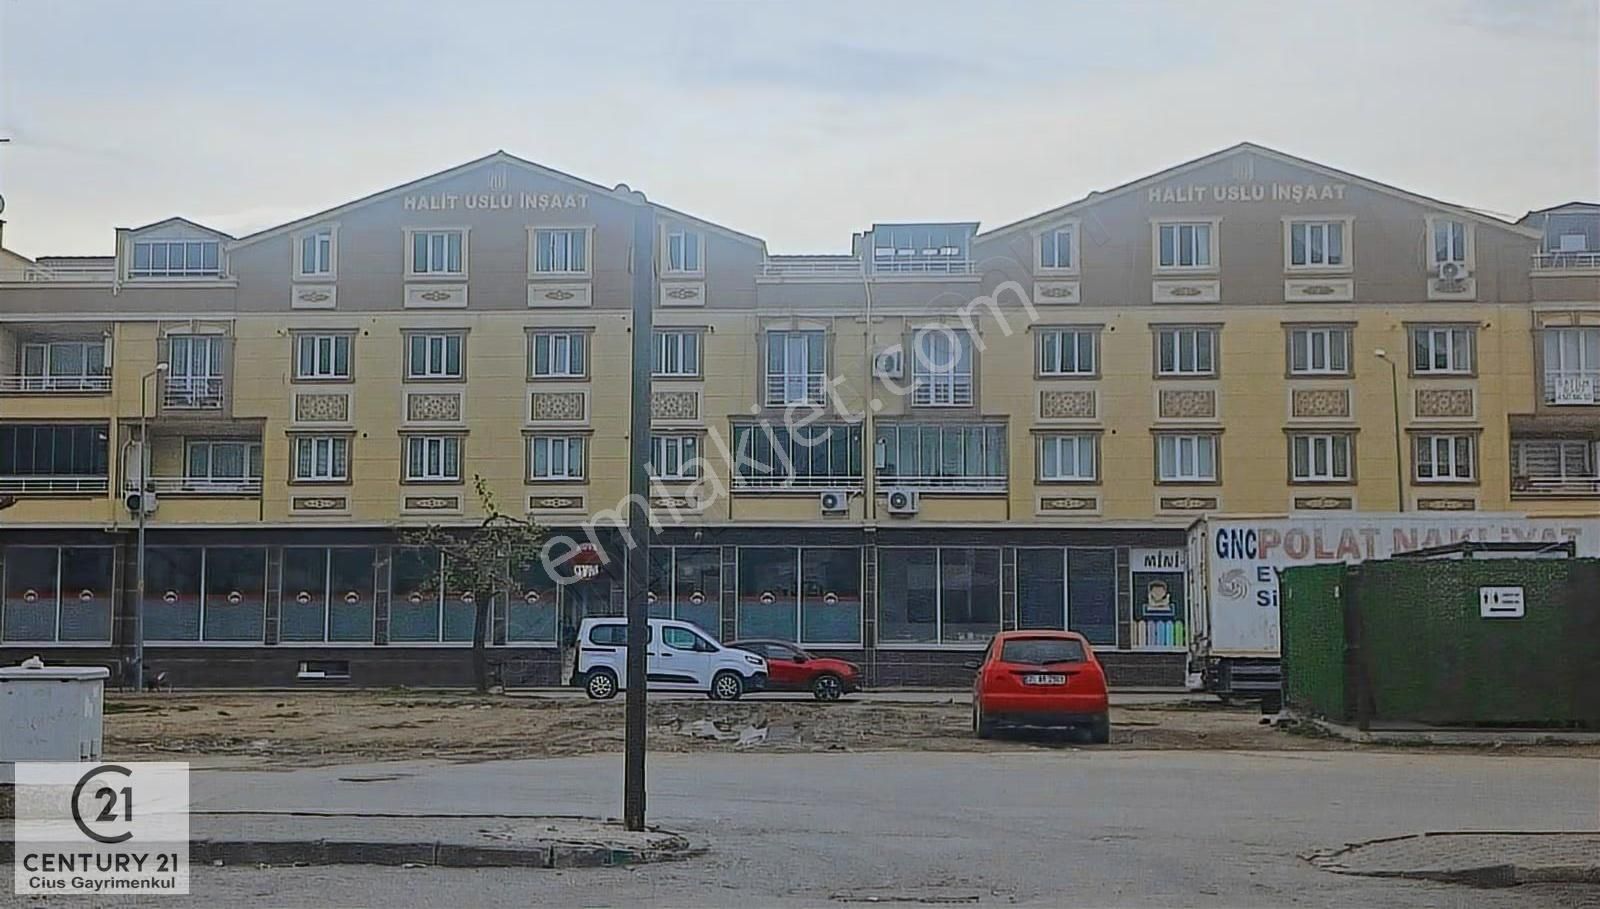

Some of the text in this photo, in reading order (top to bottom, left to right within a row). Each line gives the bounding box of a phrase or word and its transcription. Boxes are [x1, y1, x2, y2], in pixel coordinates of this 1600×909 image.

[403, 192, 590, 212] HALİT USLU İNŞAAT
[1149, 183, 1347, 203] HALİT USLU İNŞAAT
[1215, 528, 1257, 559] GNC
[1258, 528, 1381, 560] POLAT
